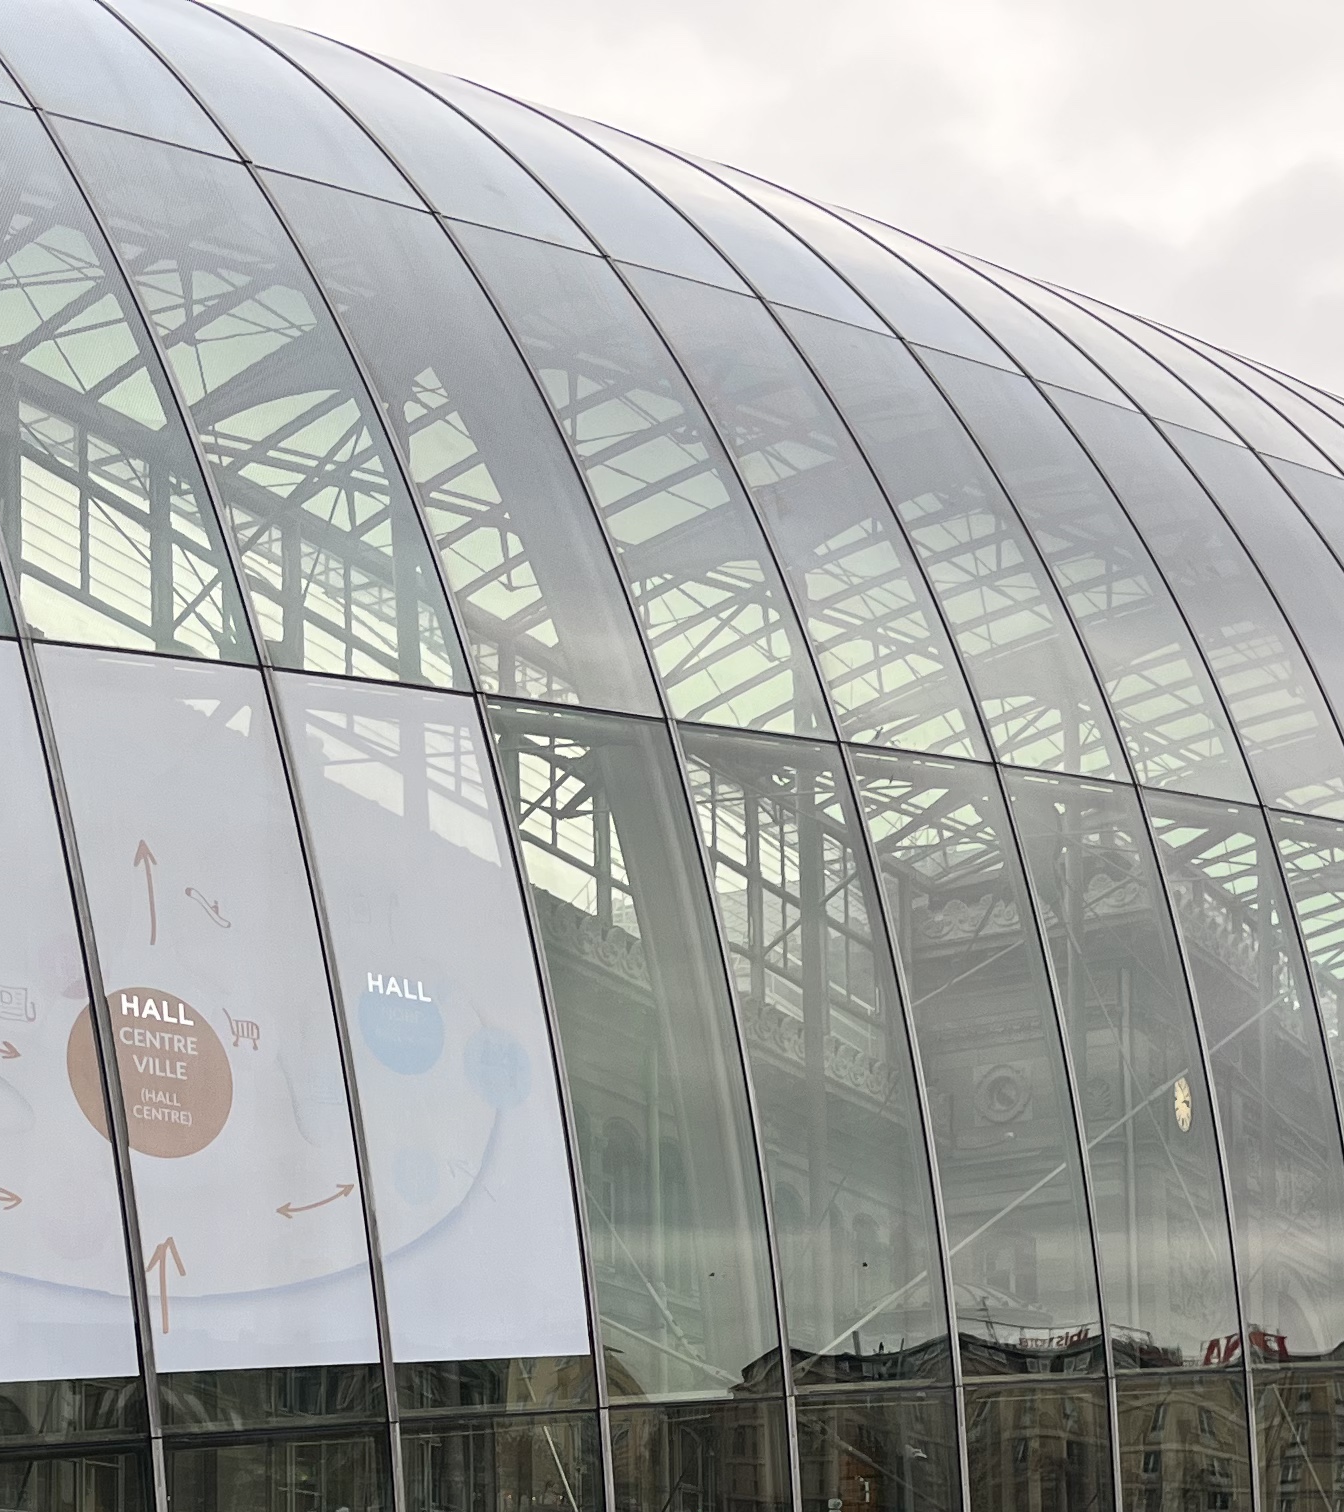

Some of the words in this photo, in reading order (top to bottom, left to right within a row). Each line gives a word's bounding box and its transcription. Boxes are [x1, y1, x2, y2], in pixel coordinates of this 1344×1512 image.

[366, 972, 431, 1002] HALL
[120, 993, 194, 1027] HALL
[119, 1027, 198, 1055] CENTRE
[133, 1055, 188, 1080] VILLE
[140, 1088, 181, 1107] (HALL
[133, 1104, 193, 1126] CENTRE)
